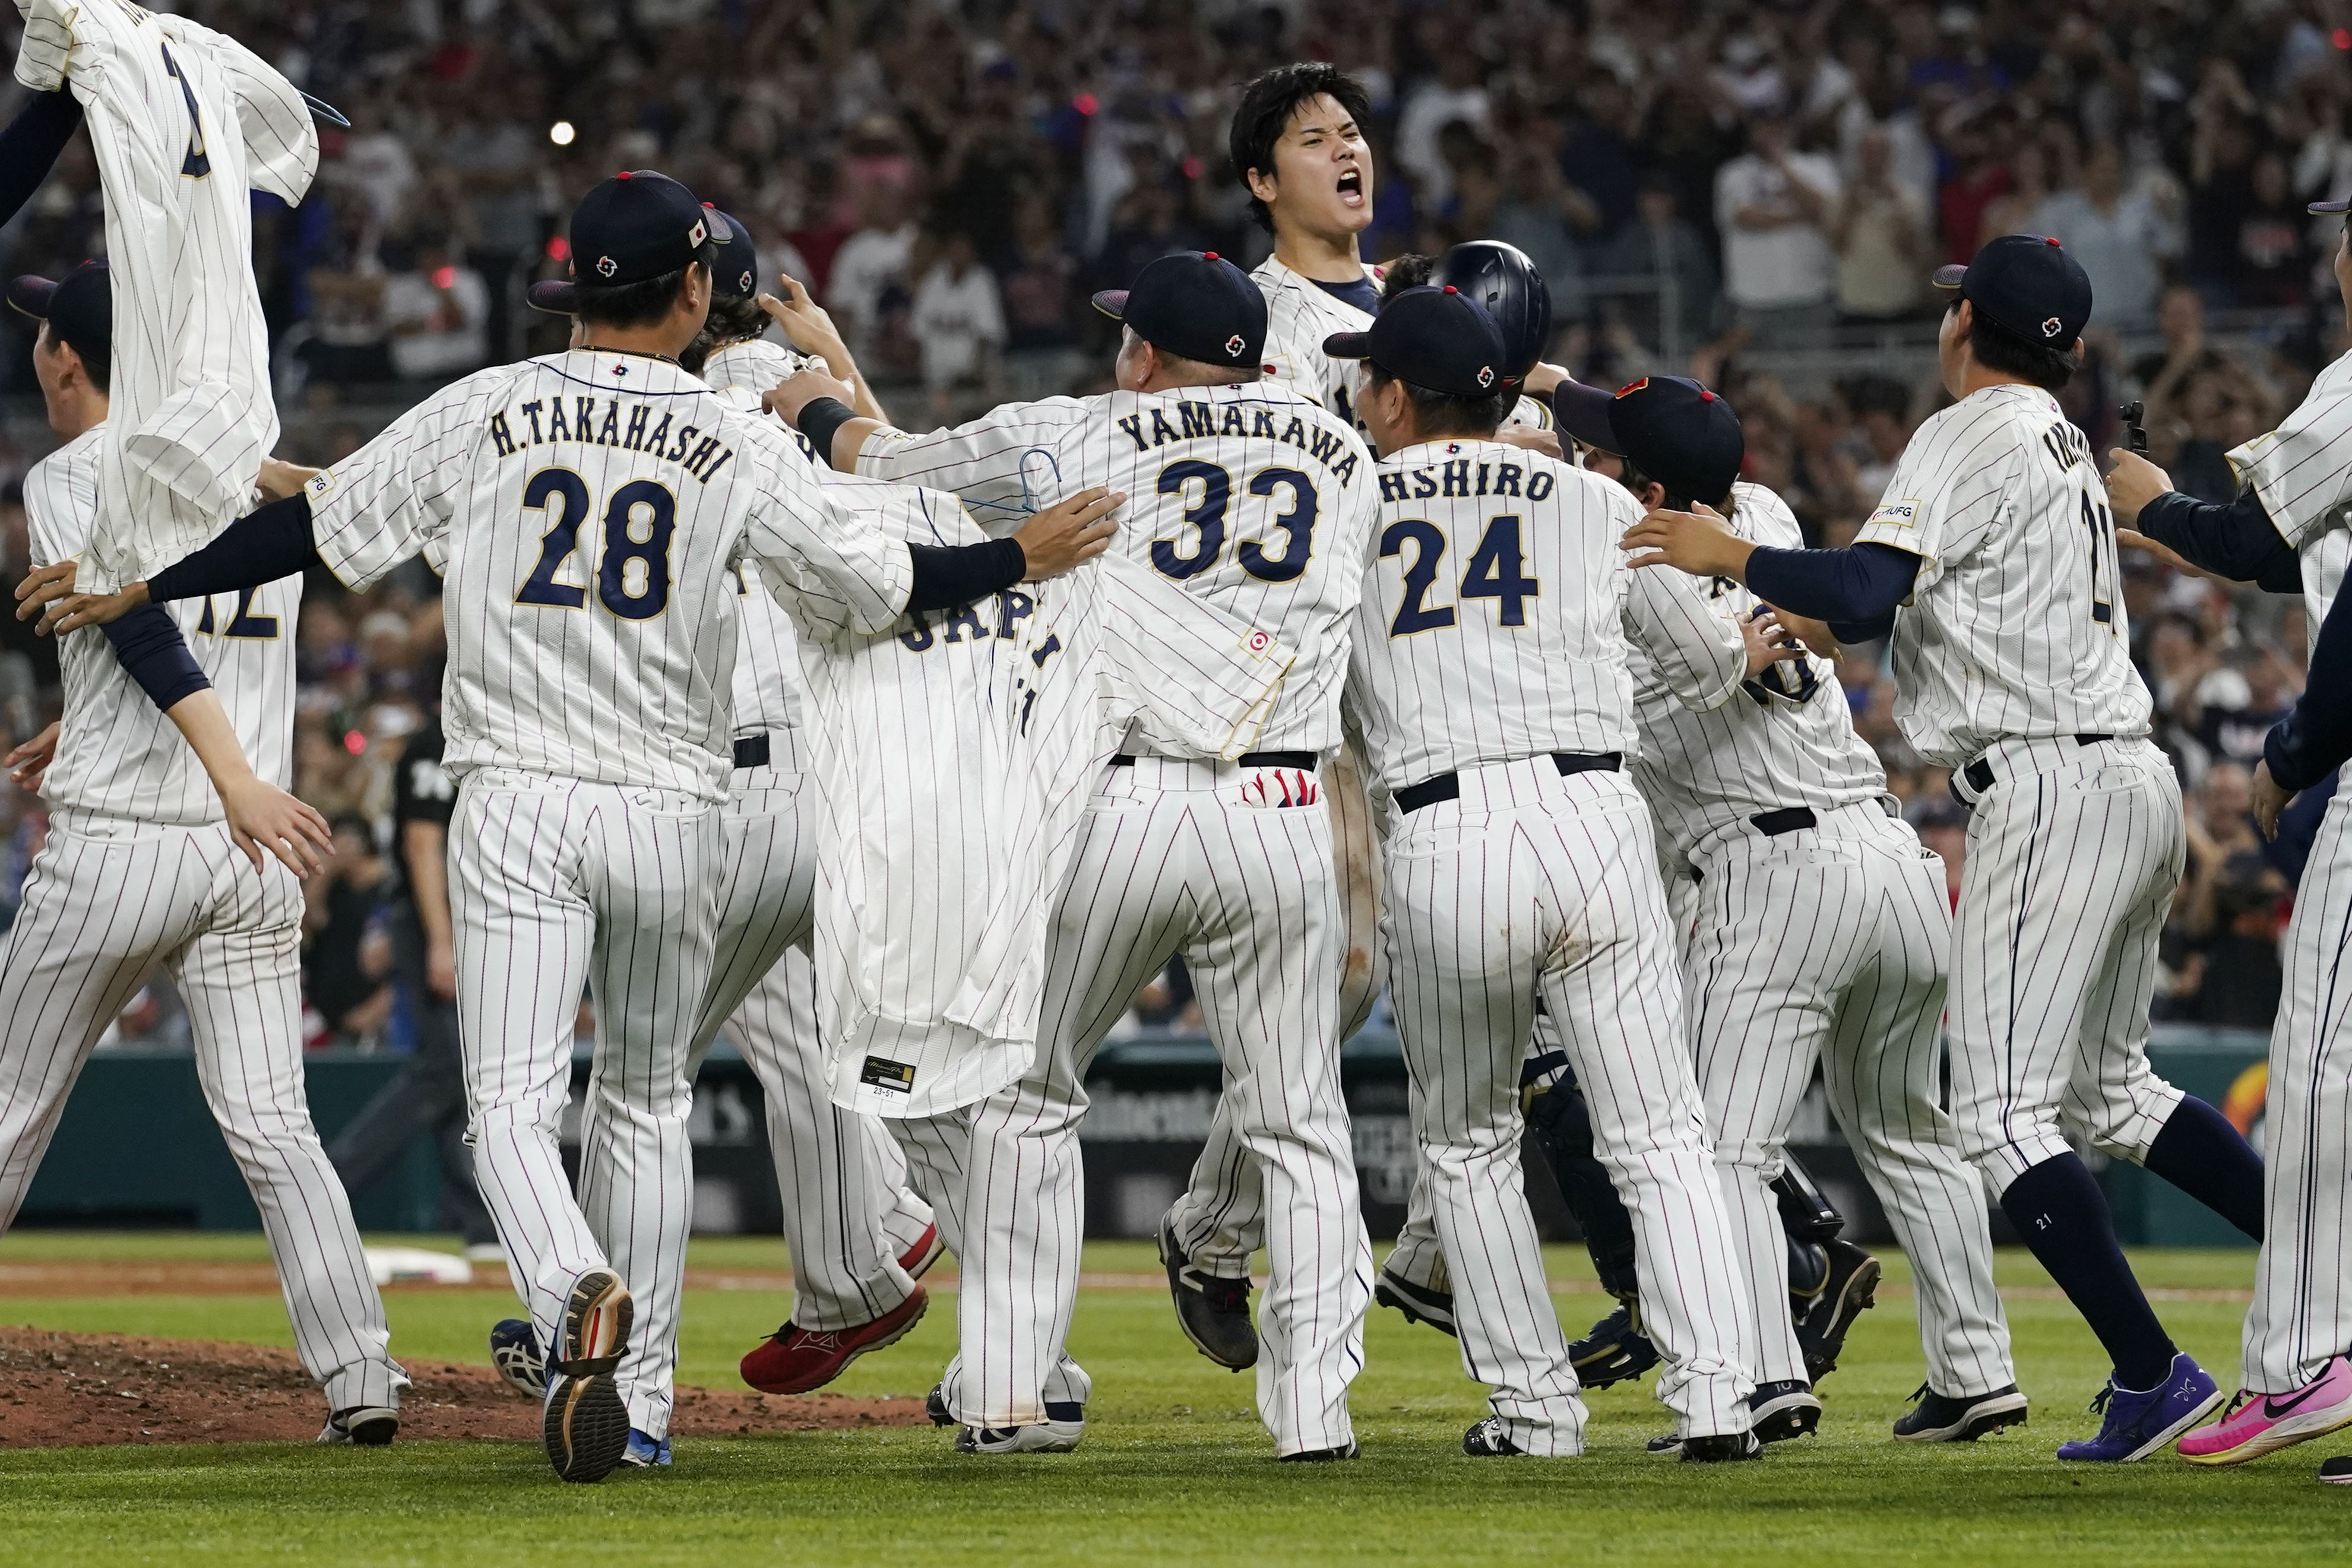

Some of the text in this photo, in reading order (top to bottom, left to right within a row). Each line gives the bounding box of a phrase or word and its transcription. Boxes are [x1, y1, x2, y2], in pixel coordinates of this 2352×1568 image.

[490, 396, 733, 485] H.TAKAHASHI
[1118, 401, 1359, 489] YAMAKAWA
[514, 465, 679, 623] 28
[1147, 457, 1322, 585] 33
[1378, 514, 1541, 640] 24
[873, 1086, 894, 1098] 23-51
[2036, 1213, 2052, 1230] 21
